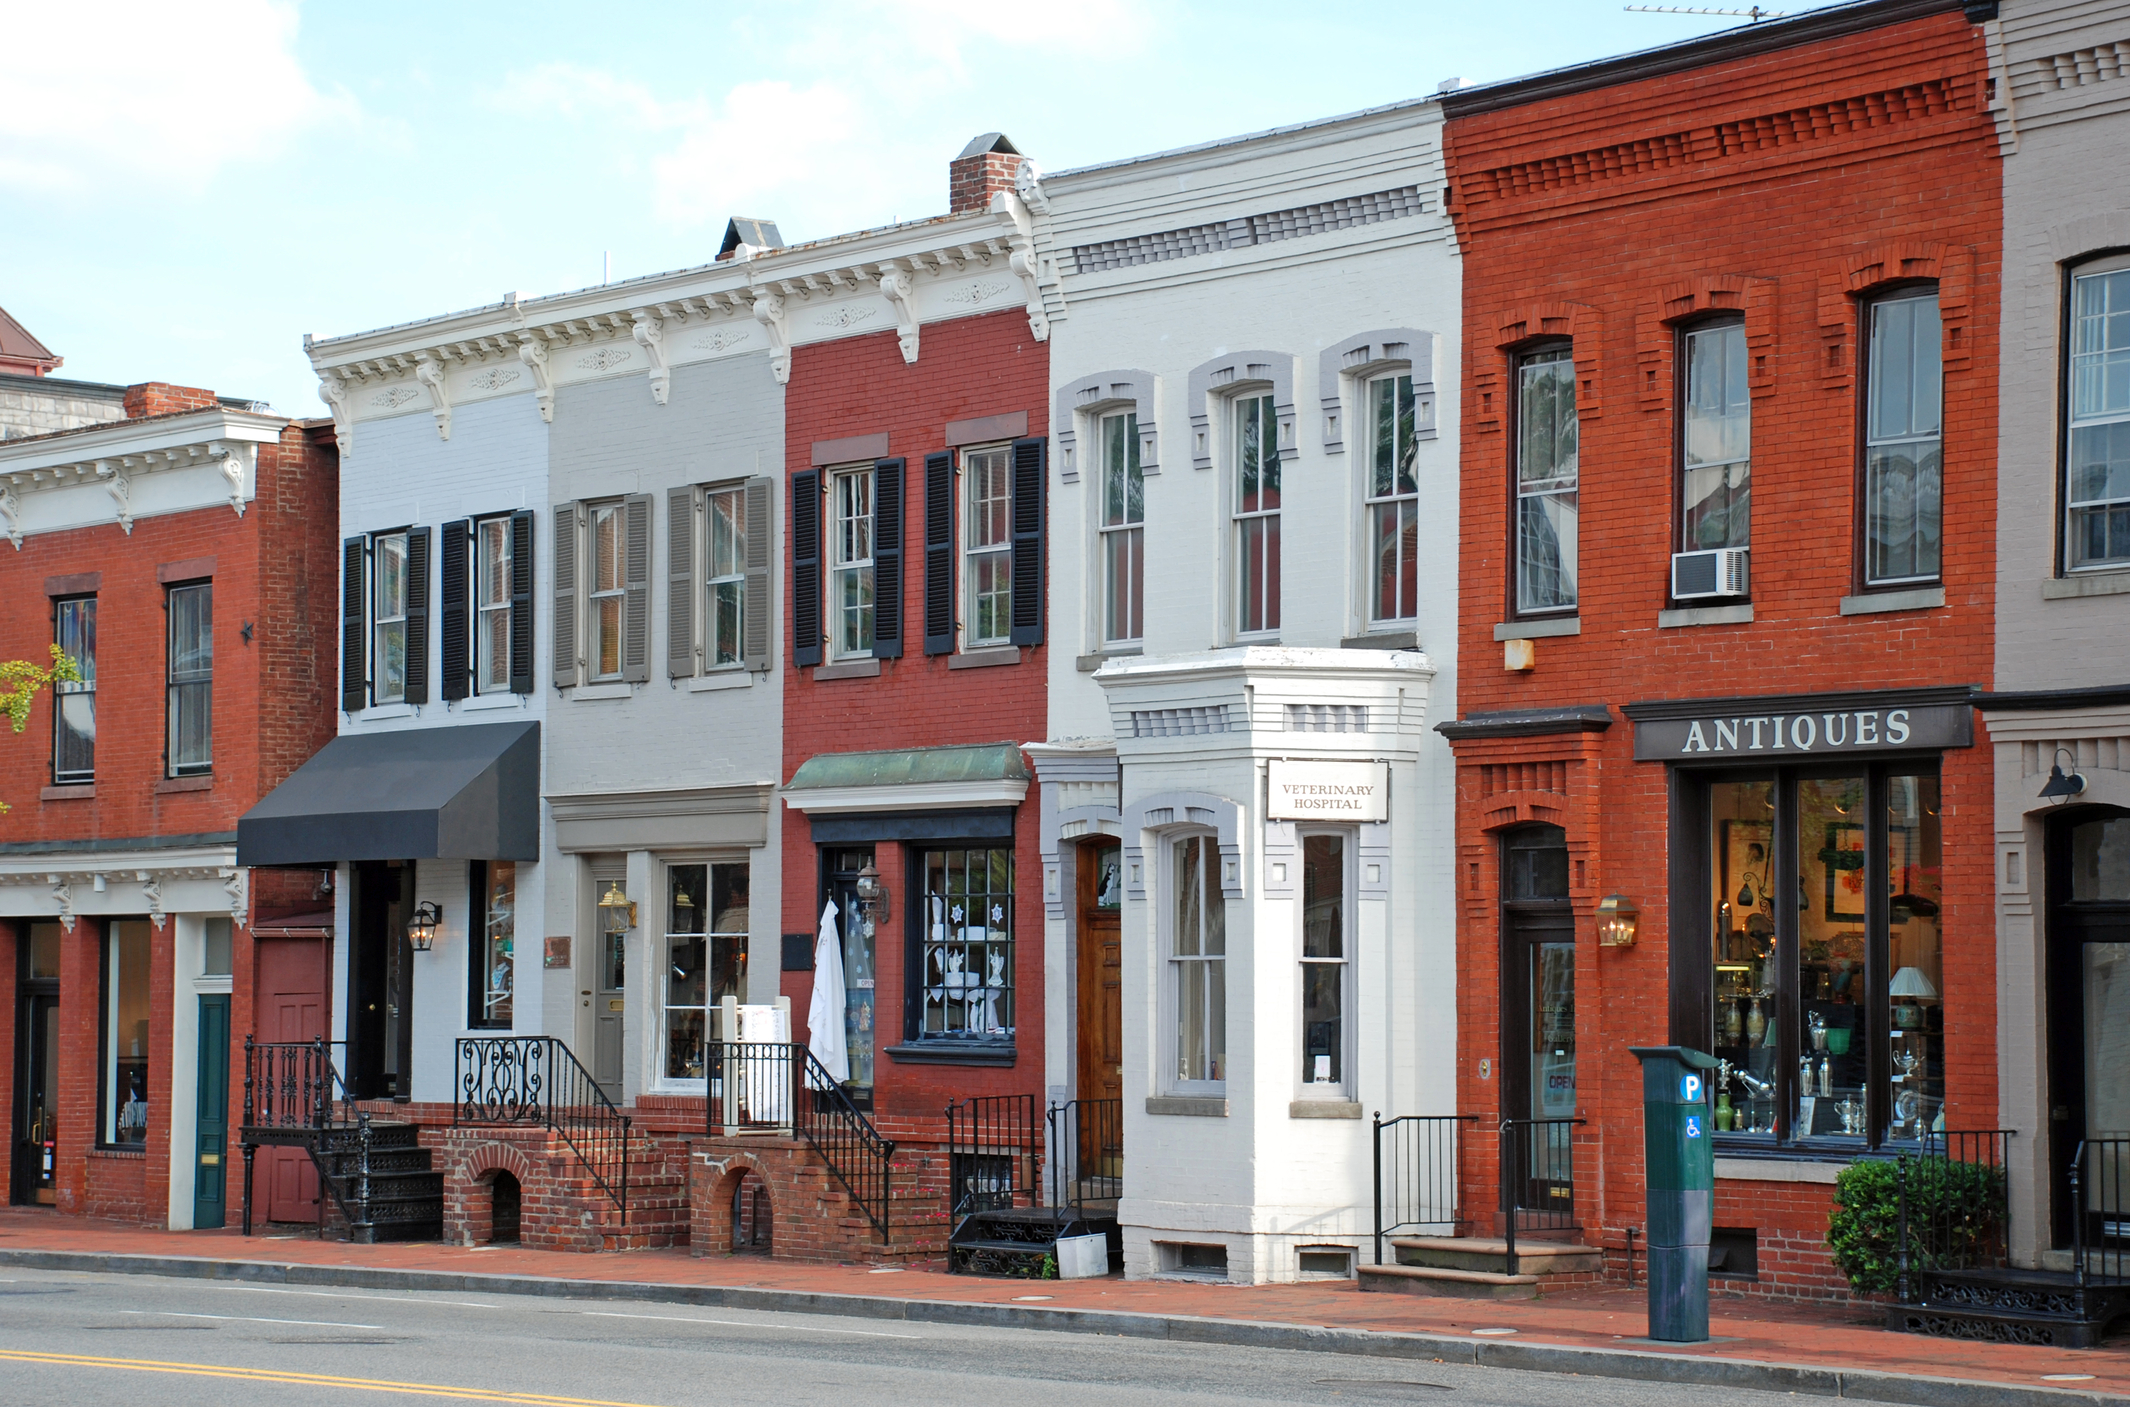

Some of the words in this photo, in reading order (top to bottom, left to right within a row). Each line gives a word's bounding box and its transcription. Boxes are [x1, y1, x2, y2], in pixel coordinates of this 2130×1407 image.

[1682, 710, 1910, 751] ANTIQUES
[1282, 784, 1374, 795] VETERINARY
[1294, 799, 1362, 809] HOSPITAL
[1549, 1075, 1575, 1089] OPEN
[1686, 1075, 1699, 1100] P
